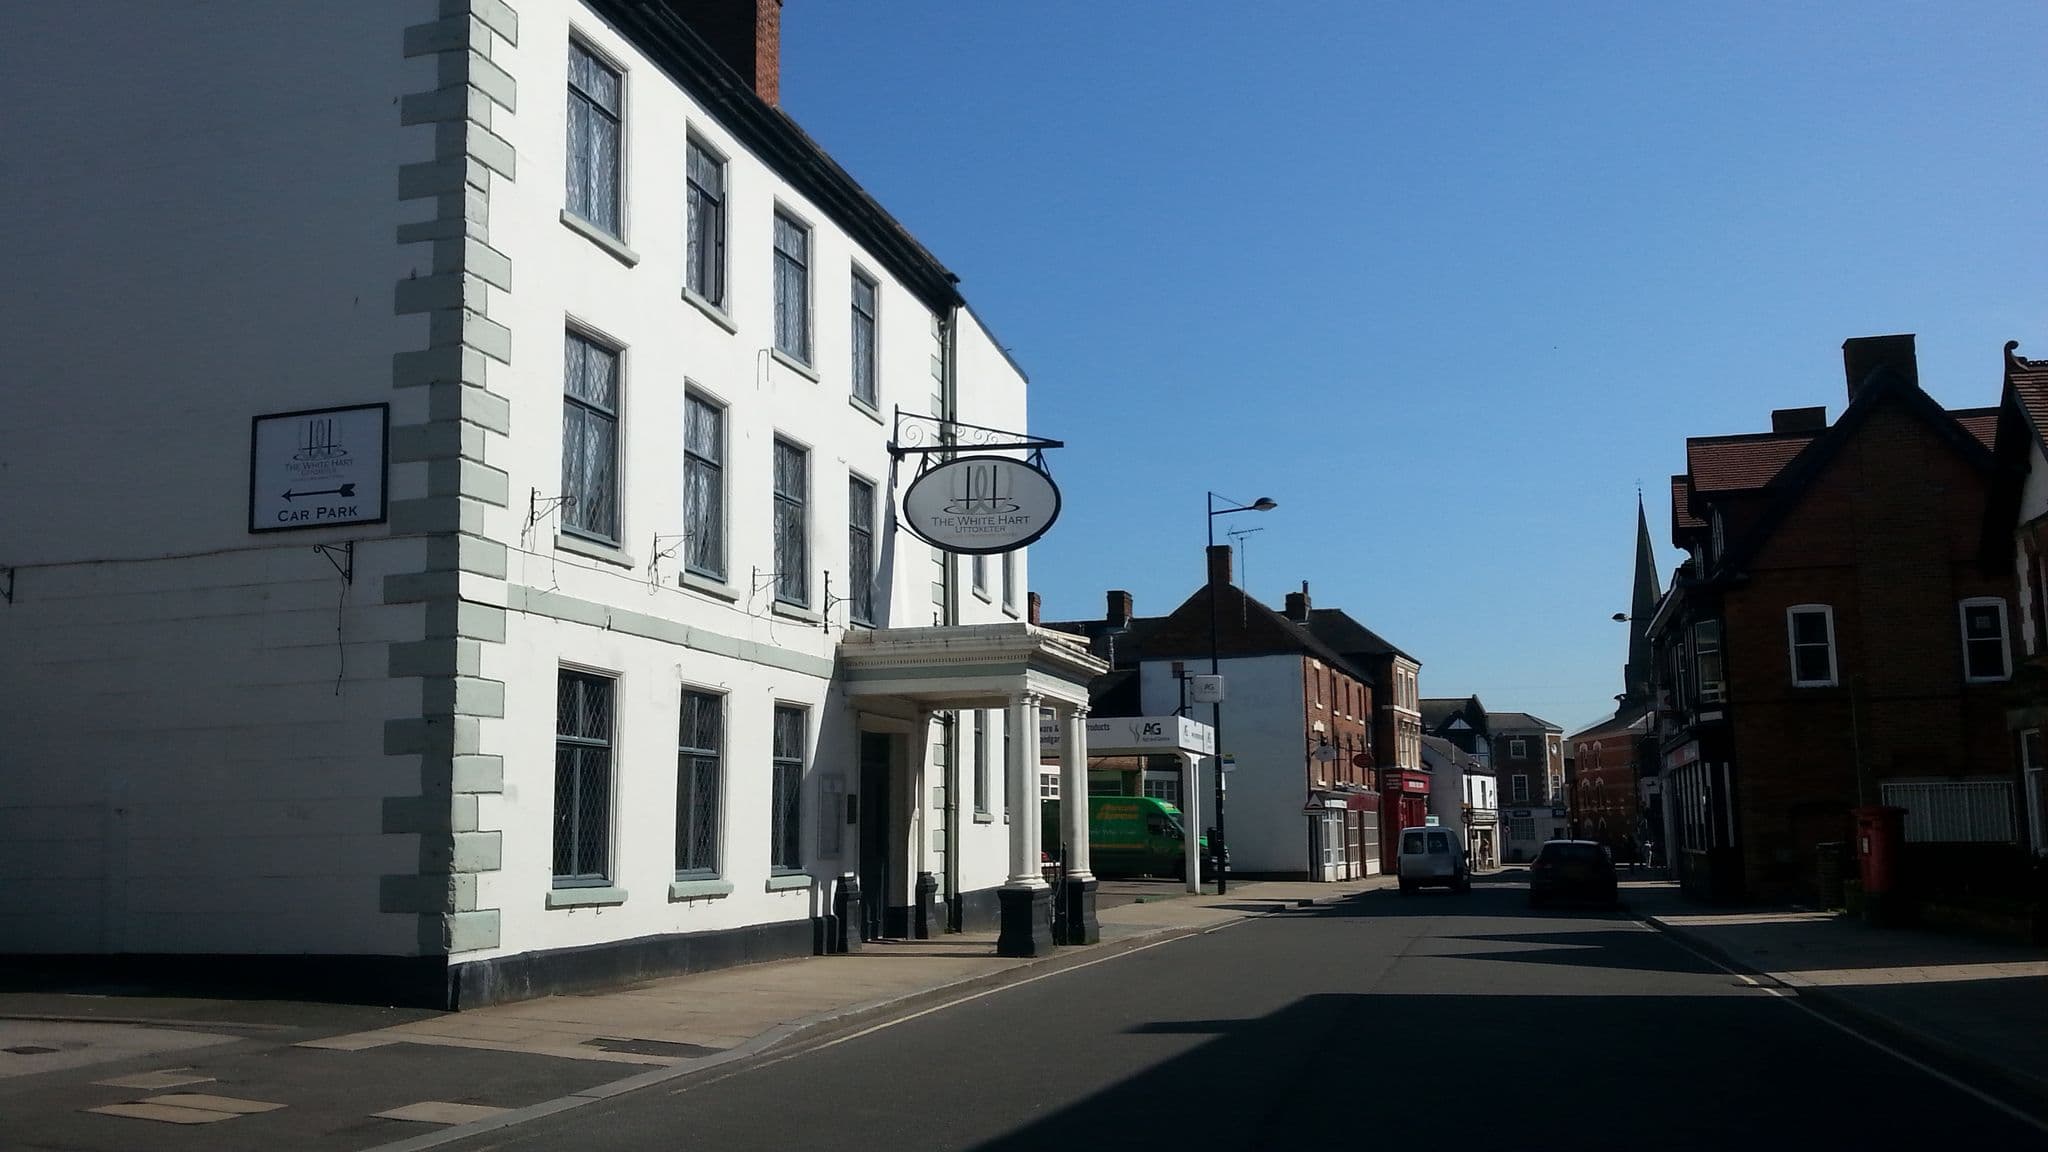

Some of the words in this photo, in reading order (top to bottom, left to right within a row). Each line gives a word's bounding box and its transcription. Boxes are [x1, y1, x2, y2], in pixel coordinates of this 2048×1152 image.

[278, 510, 309, 522] CAR
[317, 506, 357, 519] PARK
[931, 517, 954, 527] THE
[957, 516, 995, 526] WHITE
[998, 515, 1030, 525] HART
[1143, 723, 1161, 735] AG
